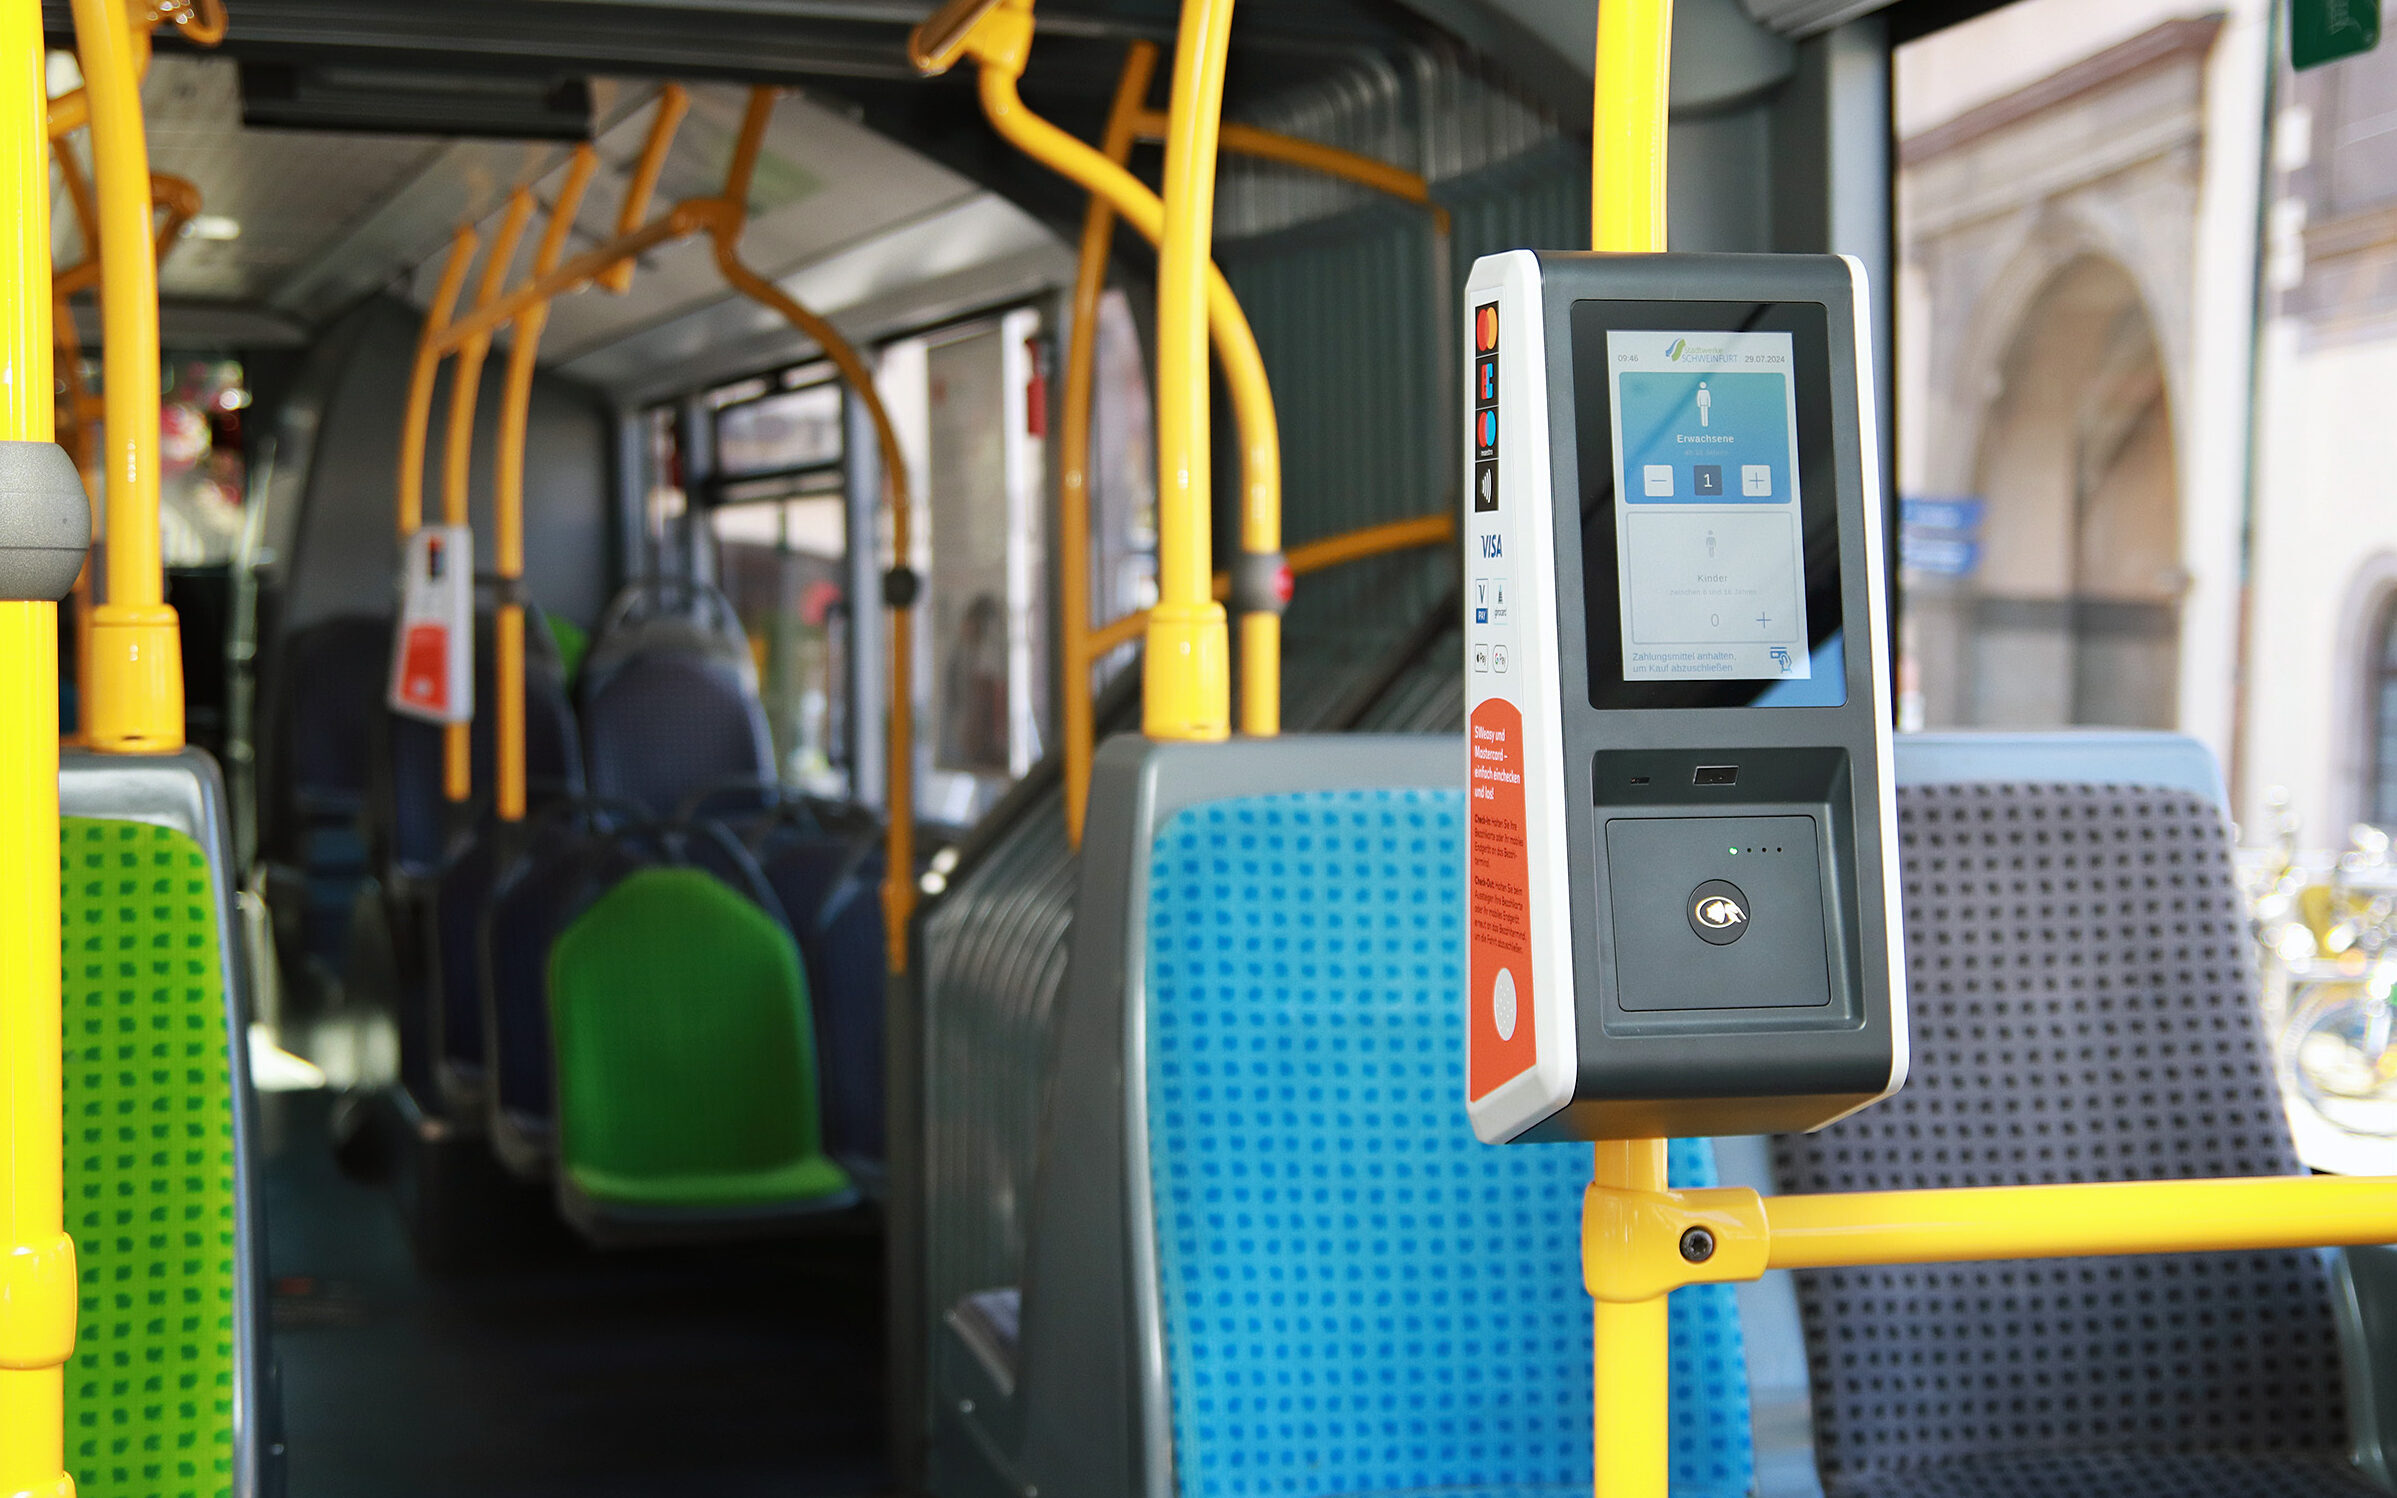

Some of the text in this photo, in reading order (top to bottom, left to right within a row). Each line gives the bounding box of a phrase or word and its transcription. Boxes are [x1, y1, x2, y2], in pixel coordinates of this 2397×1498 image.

[1682, 354, 1738, 363] SCHWEINFURT
[1744, 355, 1786, 364] 29.07.2024
[1676, 434, 1735, 444] Erwachsene
[1703, 473, 1713, 488] 1
[1481, 534, 1503, 559] VISA
[1696, 574, 1728, 583] Kinder
[1710, 613, 1720, 627] 0
[1632, 651, 1737, 663] Zahlungsmittel anhalten,
[1632, 662, 1733, 673] um Kauf abzuschließen
[1495, 728, 1505, 742] und
[1474, 745, 1504, 761] Mastercard
[1474, 765, 1520, 784] einfach einchecken
[1474, 783, 1485, 798] und
